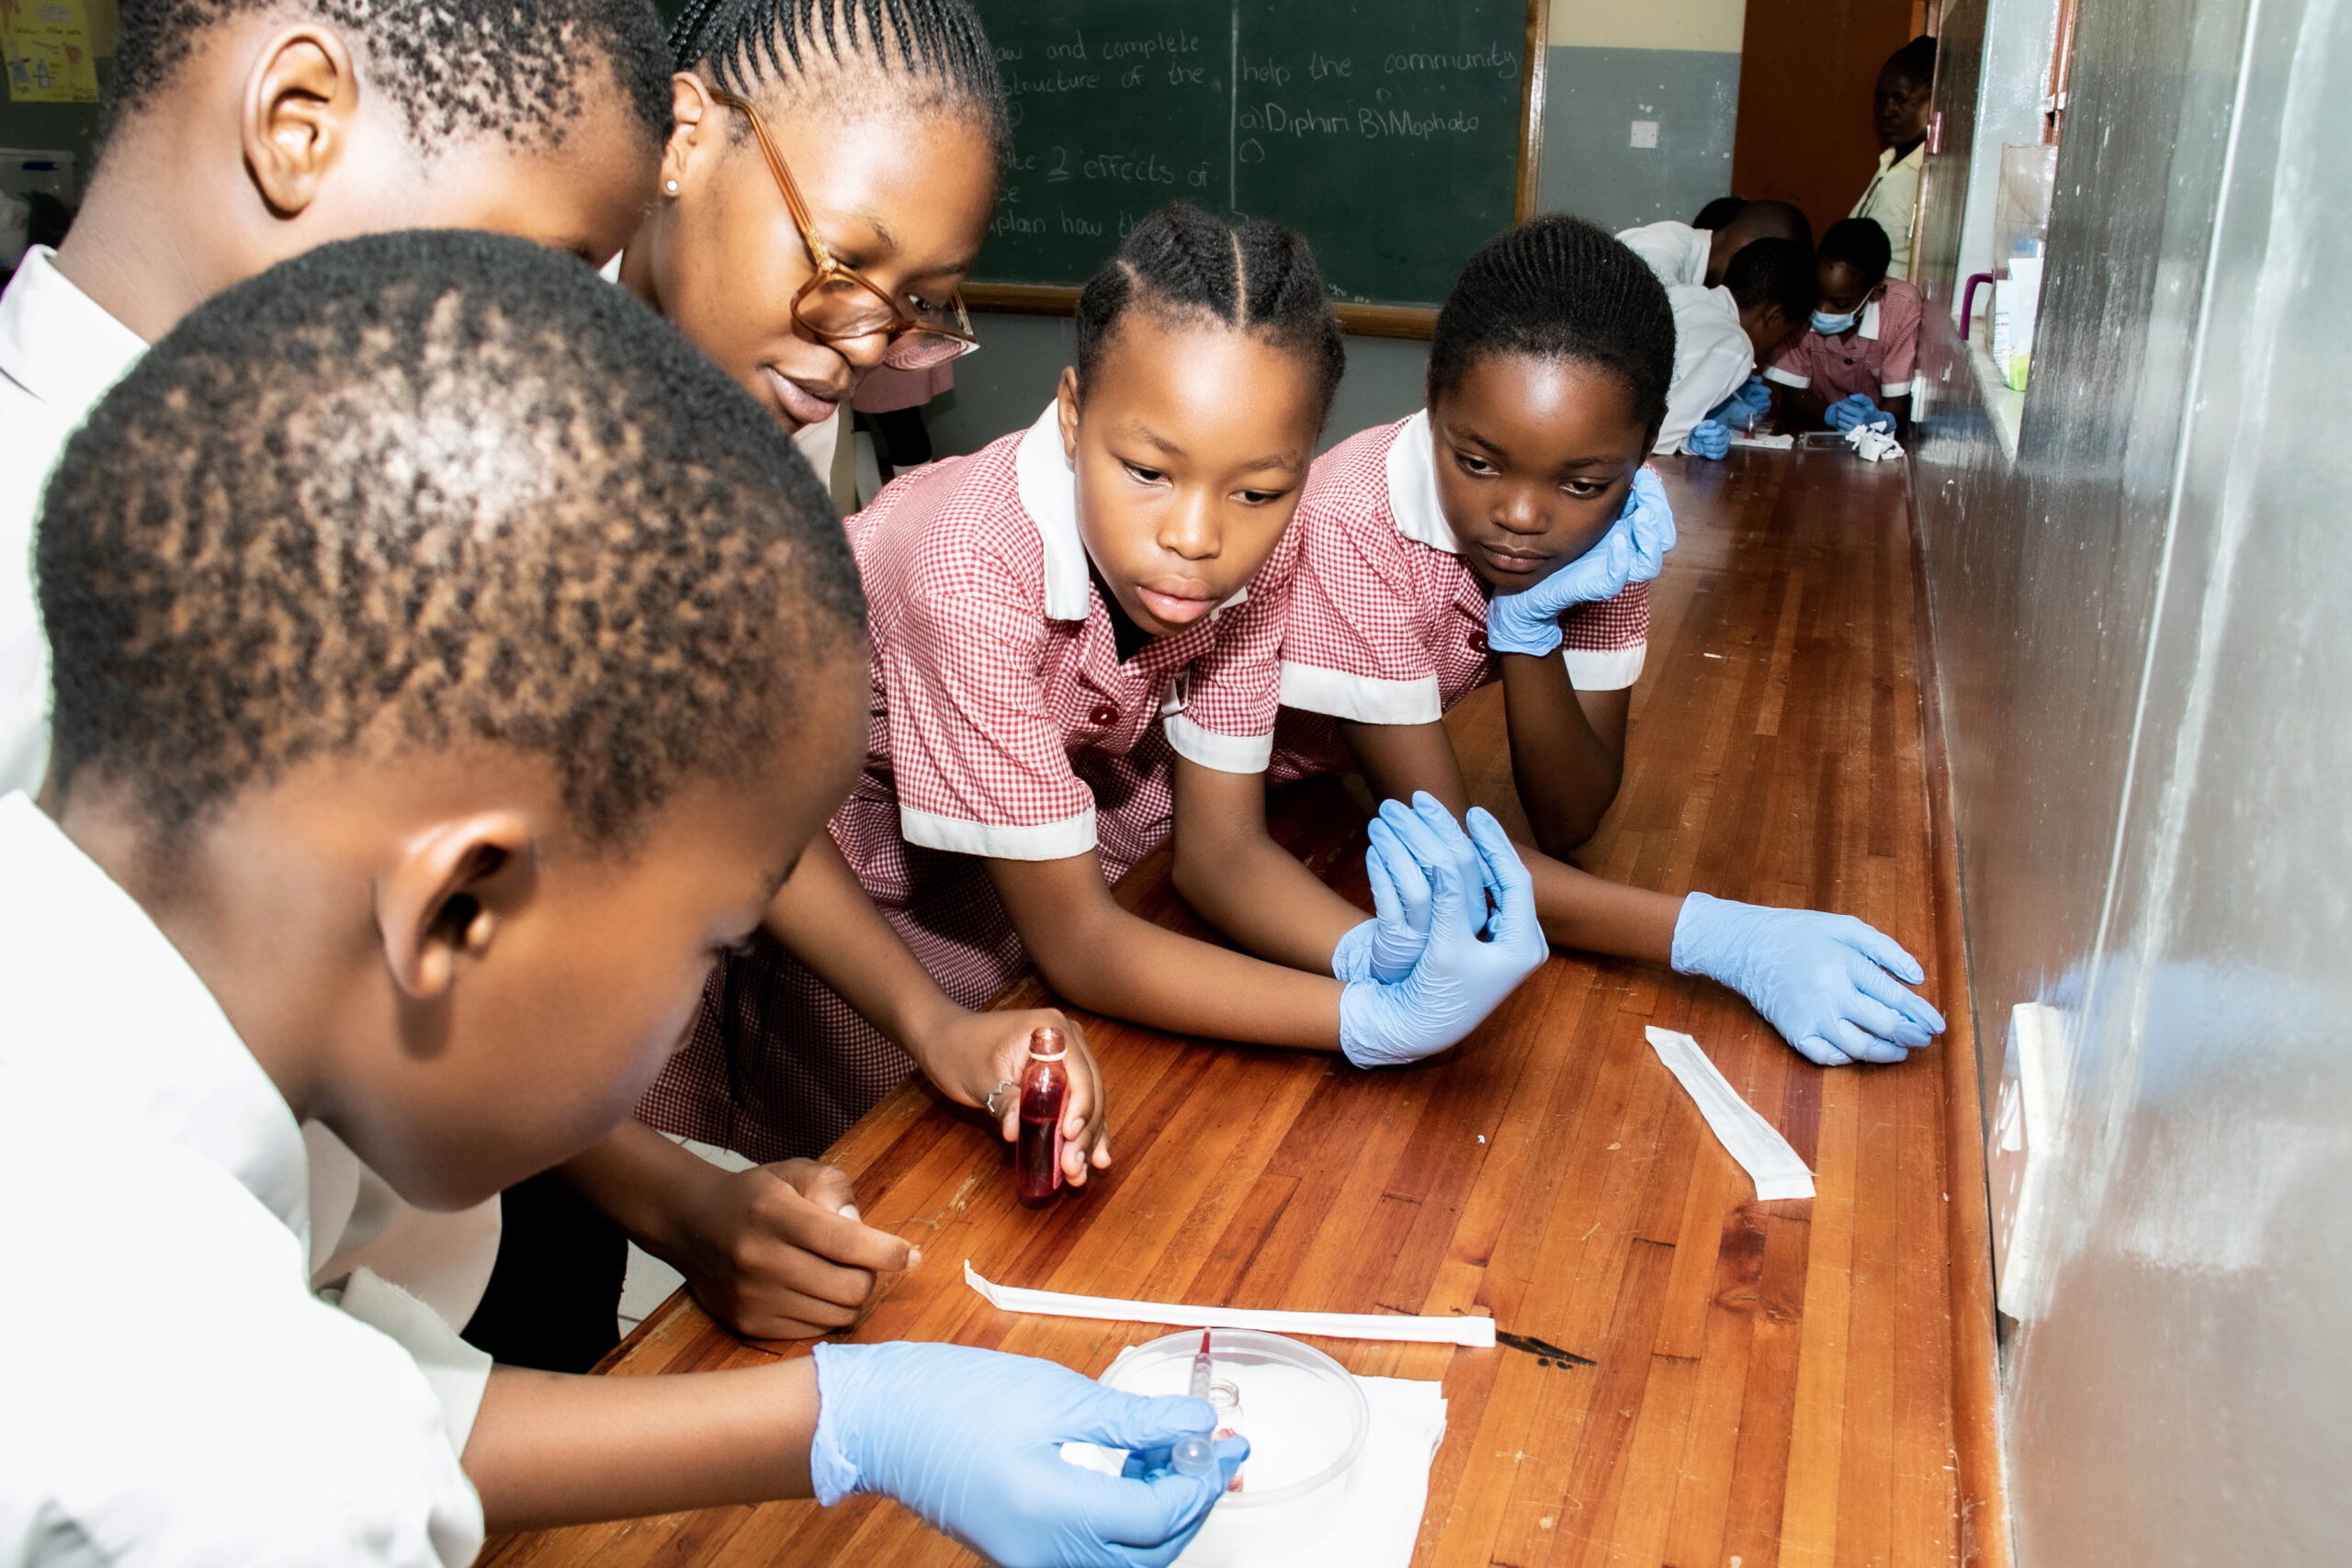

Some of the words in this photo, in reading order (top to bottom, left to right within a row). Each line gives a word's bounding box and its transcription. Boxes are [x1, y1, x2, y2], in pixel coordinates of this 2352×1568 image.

[1046, 29, 1088, 60] and
[1102, 29, 1200, 60] complete
[1242, 56, 1292, 87] help
[1309, 51, 1352, 81] the
[1384, 39, 1519, 79] community
[1001, 68, 1102, 96] structure
[1121, 63, 1146, 89] of
[1169, 59, 1205, 86] the
[1046, 145, 1071, 176] 2
[1083, 153, 1175, 186] effects
[1187, 162, 1213, 188] of
[1061, 209, 1103, 237] how
